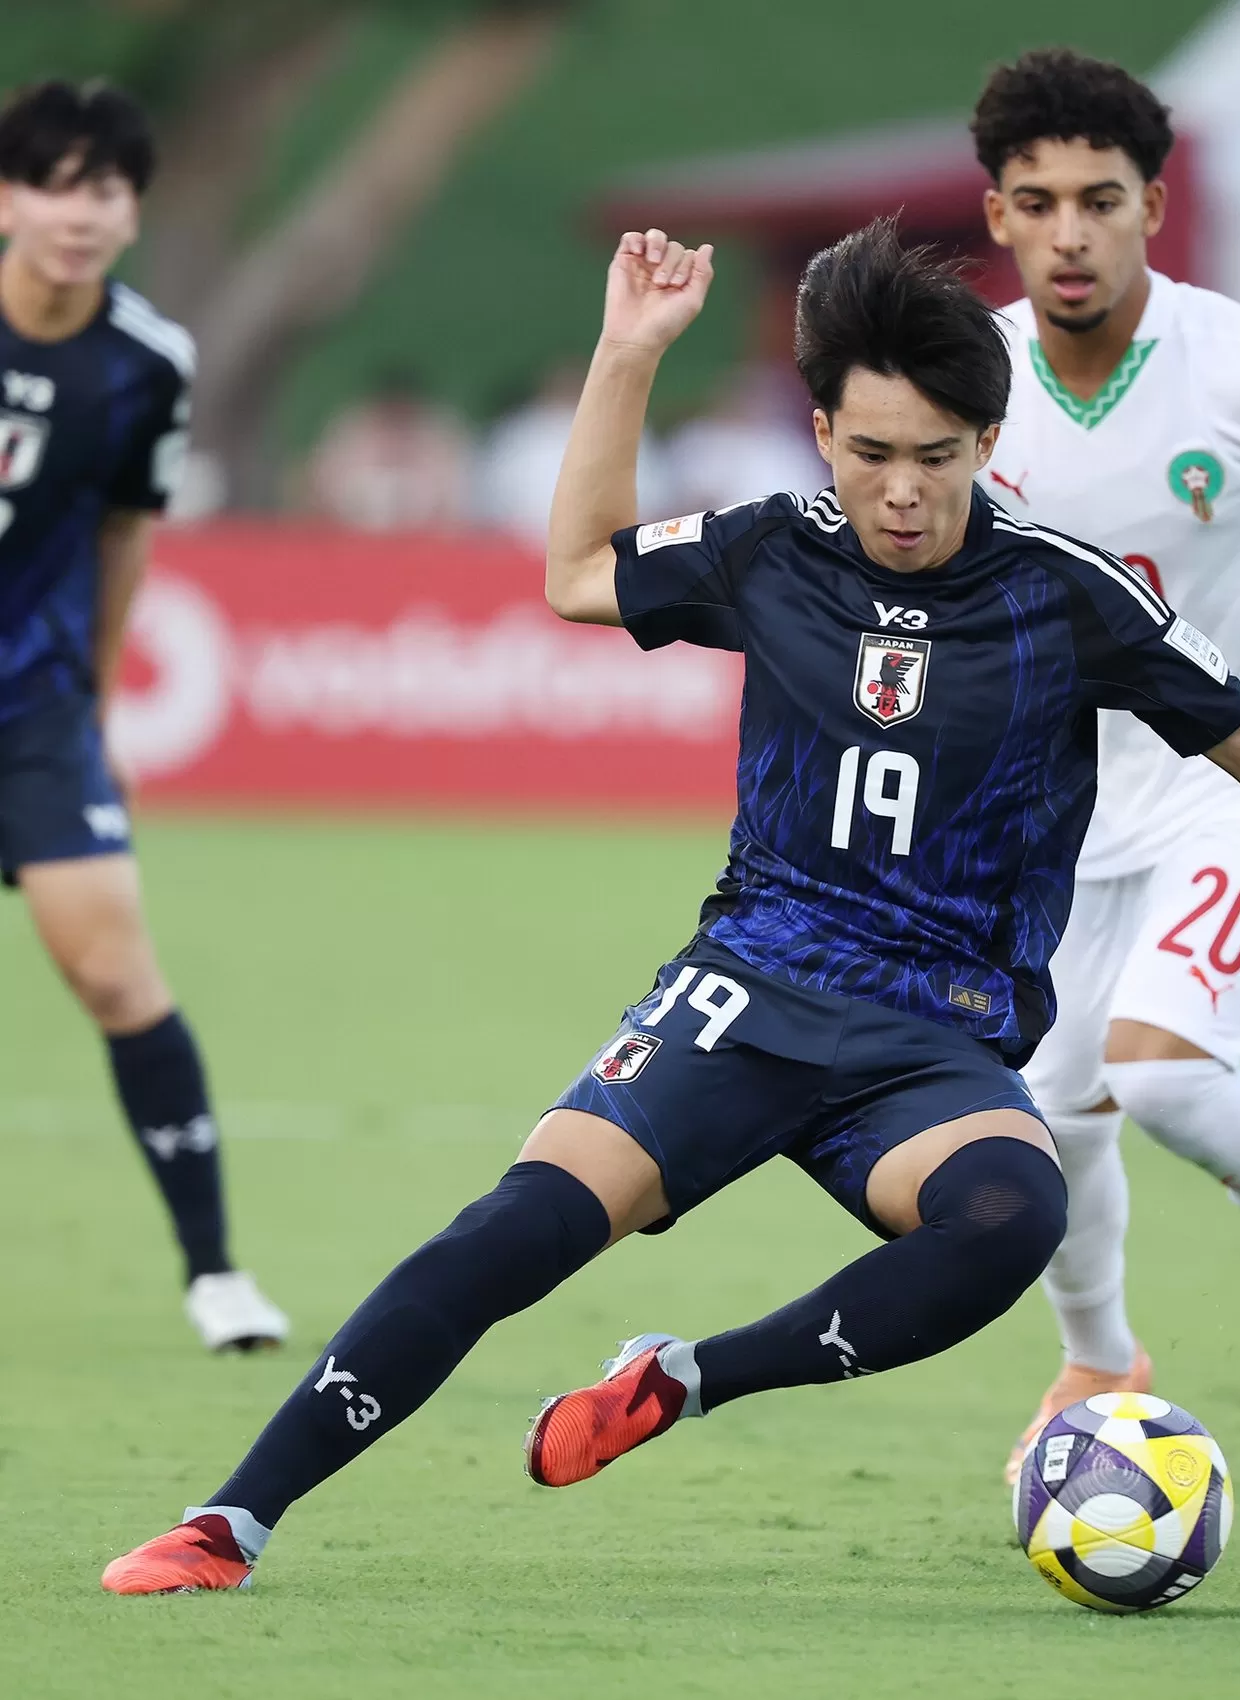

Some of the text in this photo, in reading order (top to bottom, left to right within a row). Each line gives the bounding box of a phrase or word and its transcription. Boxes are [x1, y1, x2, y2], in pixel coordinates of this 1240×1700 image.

[872, 600, 929, 630] Y-3
[878, 639, 914, 650] JAPAN
[871, 696, 902, 713] JFA
[830, 745, 920, 856] 19
[640, 965, 750, 1053] 19
[313, 1355, 382, 1431] Y-3
